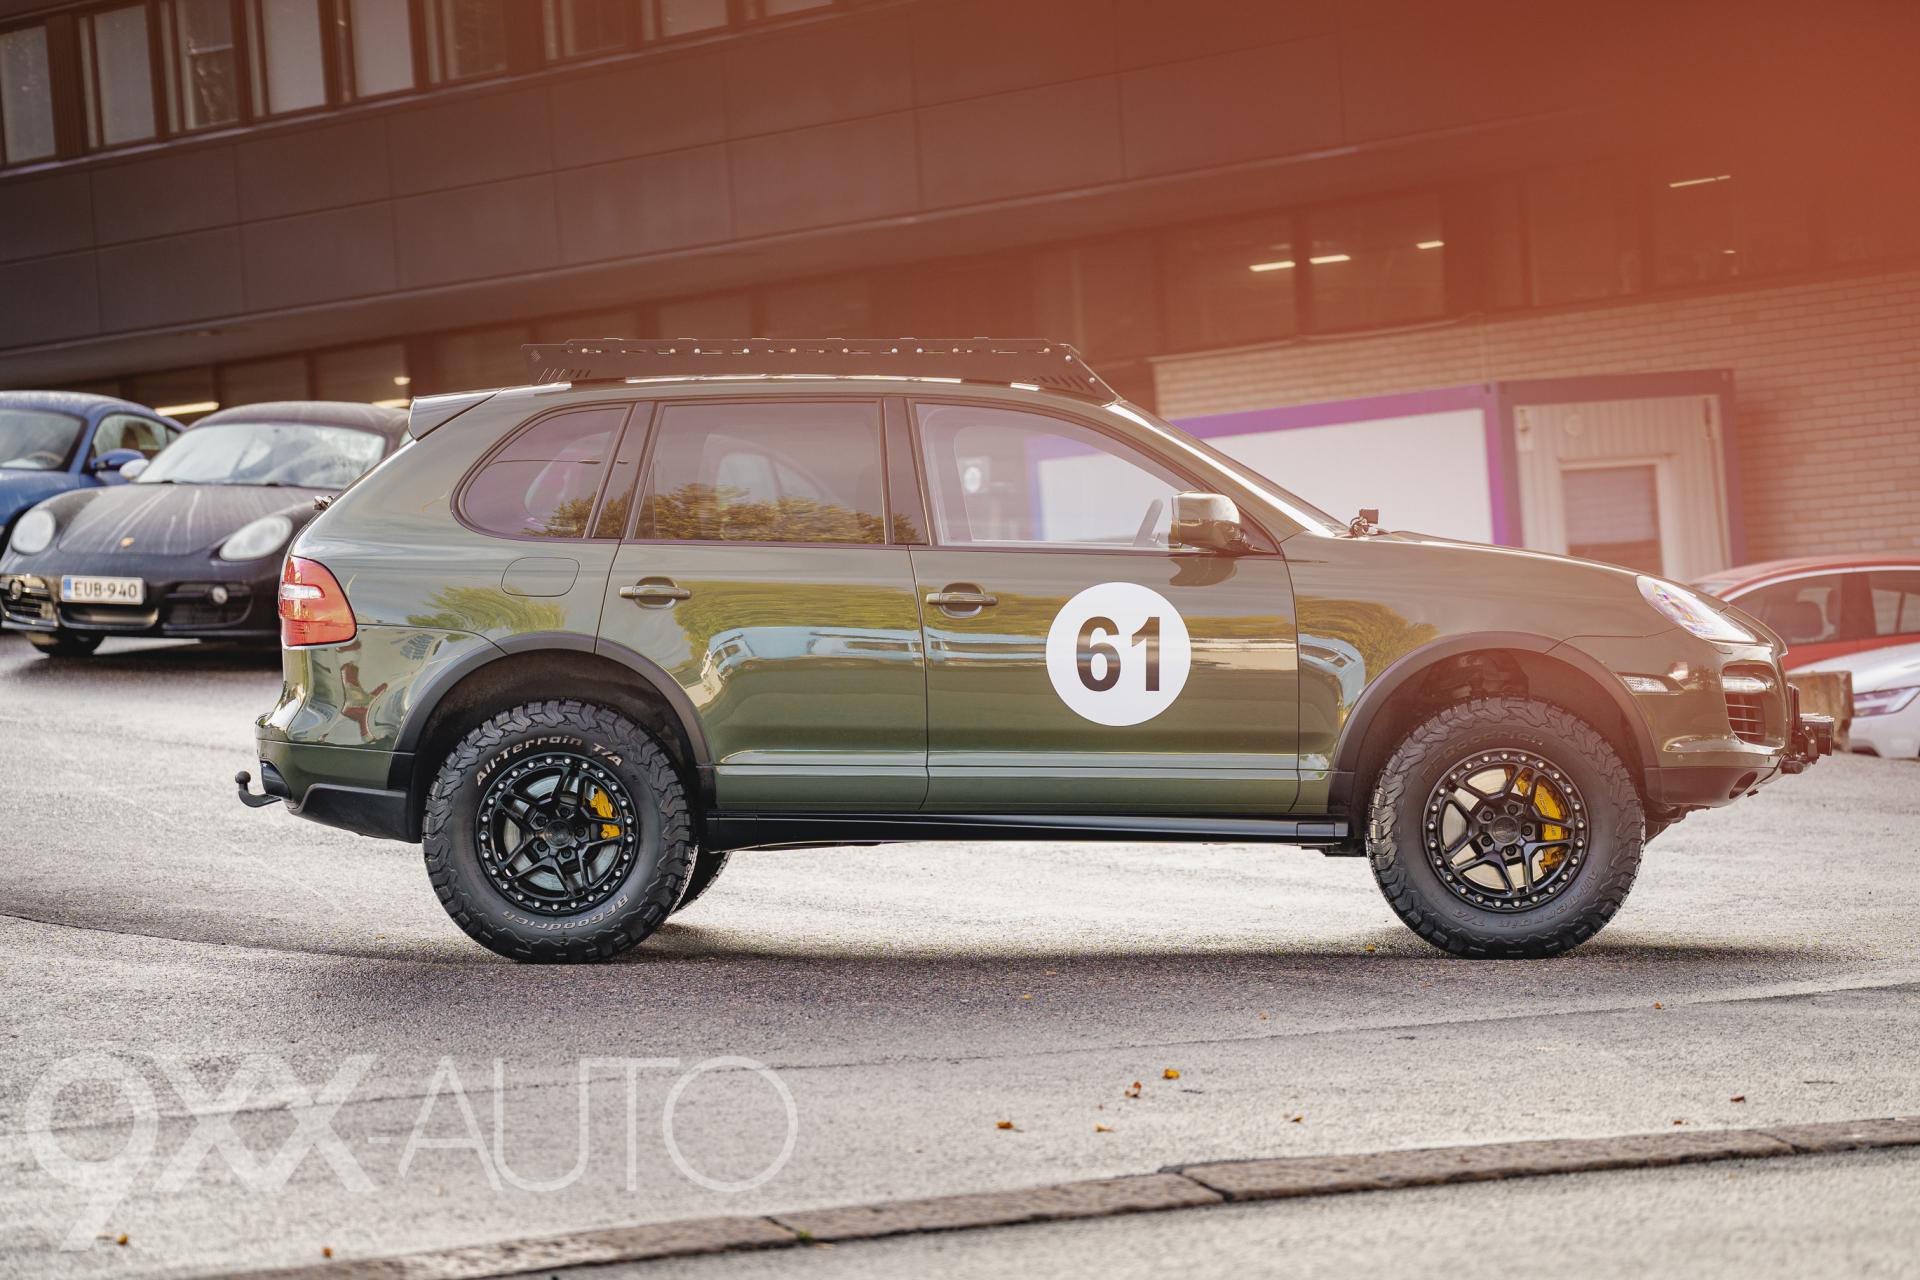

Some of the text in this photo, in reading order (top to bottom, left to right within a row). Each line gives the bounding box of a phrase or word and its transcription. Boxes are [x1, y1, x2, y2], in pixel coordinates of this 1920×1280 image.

[73, 581, 137, 599] EUB-940
[1076, 616, 1160, 692] 61
[475, 735, 624, 787] All-Terrain T/A
[501, 894, 629, 932] BFGoodrich
